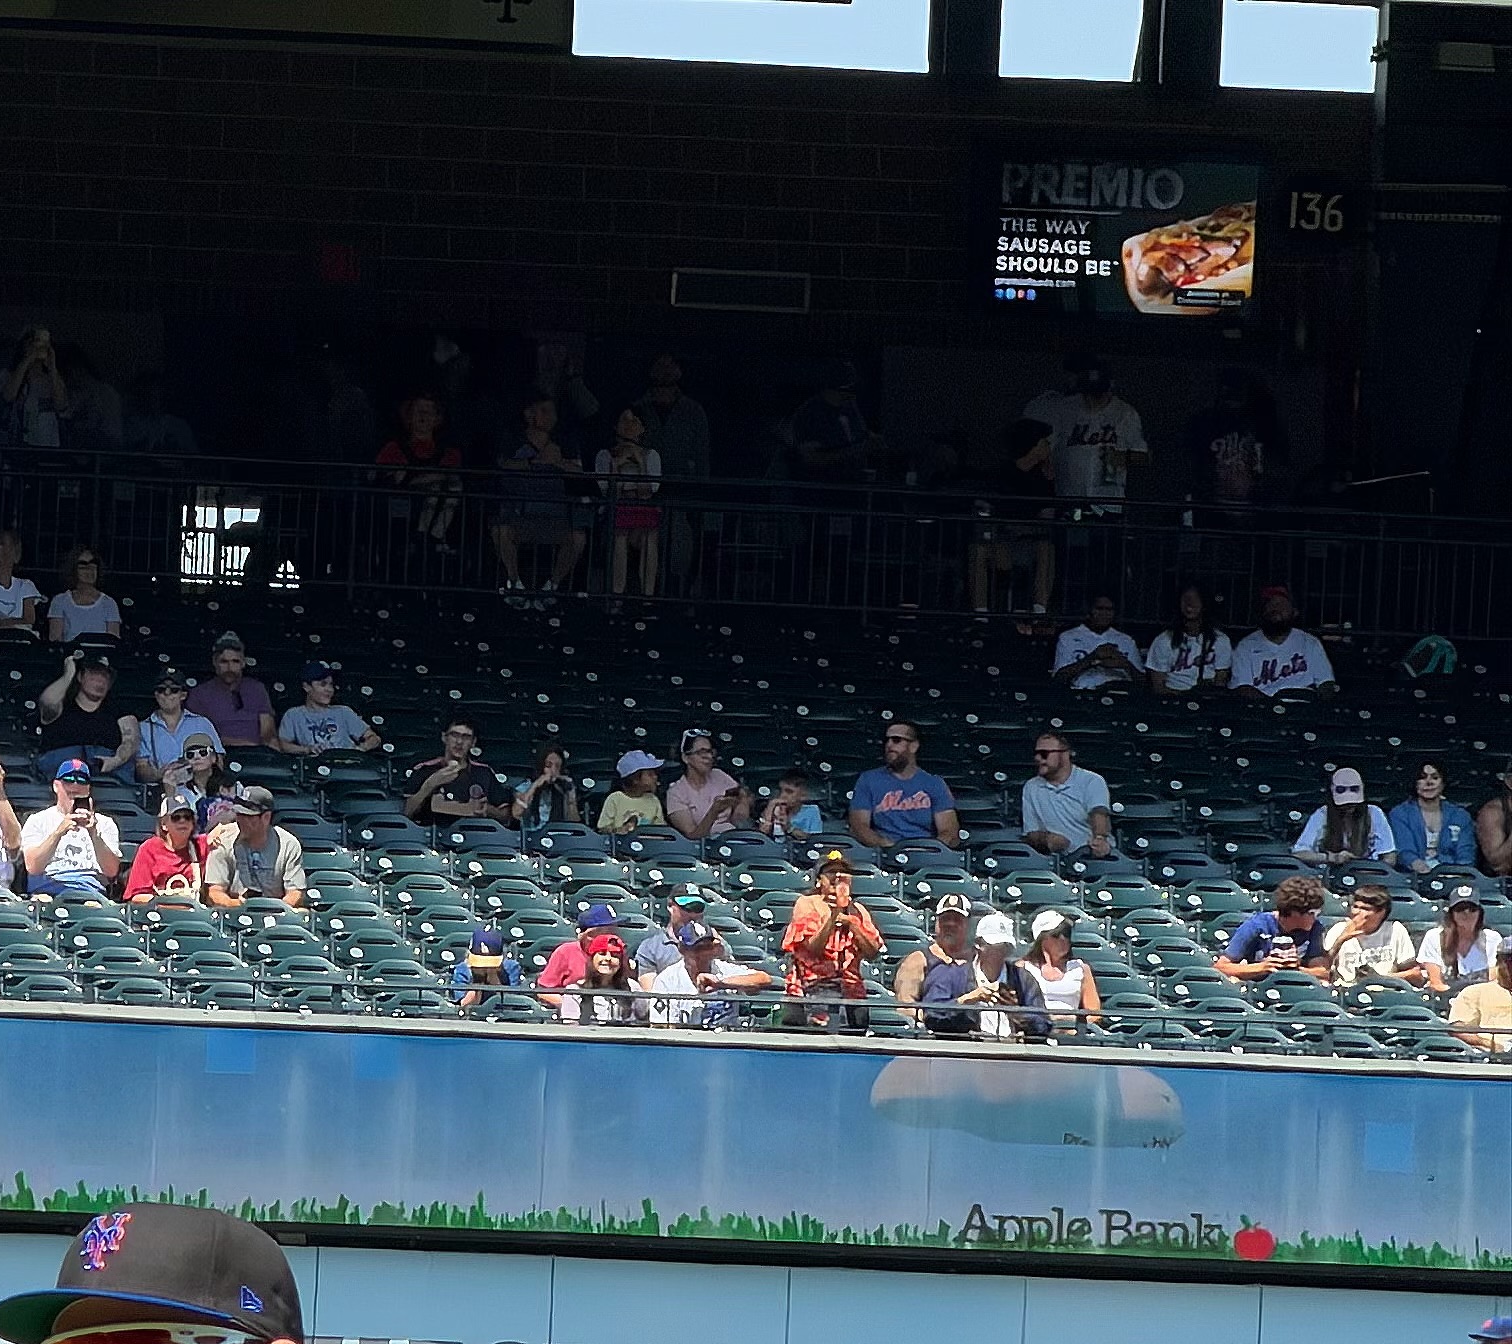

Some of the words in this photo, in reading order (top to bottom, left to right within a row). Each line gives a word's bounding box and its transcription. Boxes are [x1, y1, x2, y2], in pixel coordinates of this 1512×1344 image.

[1001, 163, 1184, 210] PREMIO
[1289, 192, 1344, 232] 136
[999, 217, 1037, 233] THE
[1045, 218, 1091, 235] WAY
[996, 236, 1091, 256] SAUSAGE
[996, 255, 1079, 275] SHOULD
[1252, 654, 1308, 686] Mets
[876, 789, 931, 811] Mets
[961, 1203, 1093, 1250] Apple
[1098, 1208, 1224, 1251] Bank
